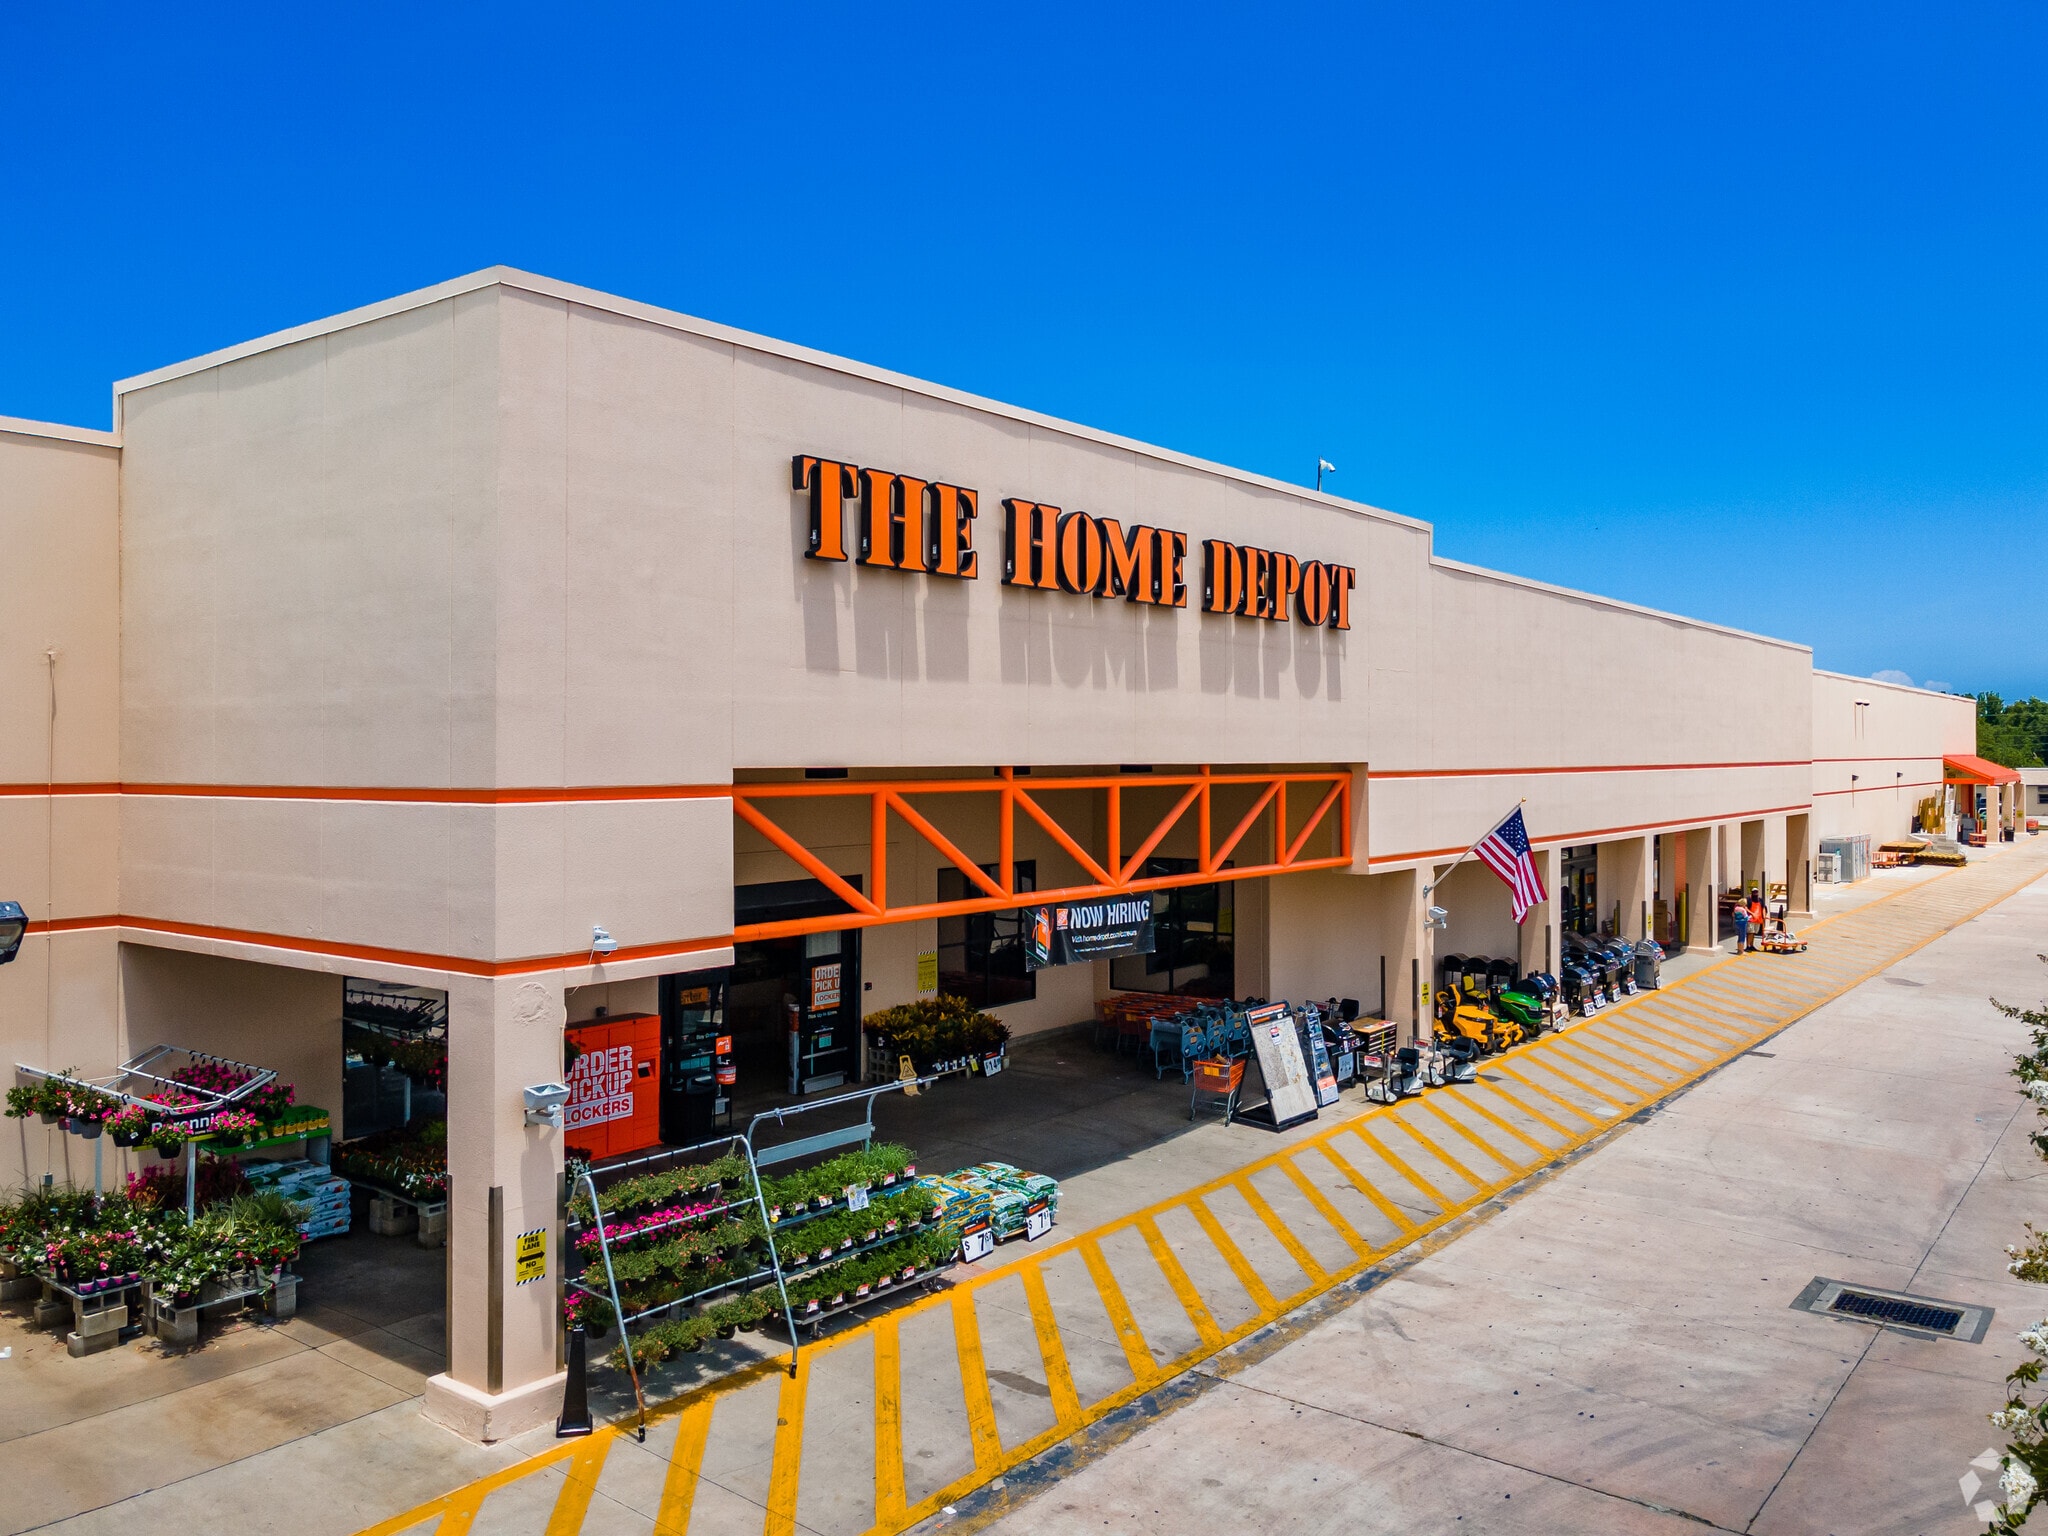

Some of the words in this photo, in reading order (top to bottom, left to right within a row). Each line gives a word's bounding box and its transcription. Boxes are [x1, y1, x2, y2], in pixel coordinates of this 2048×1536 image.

[793, 455, 979, 580] THE
[1002, 498, 1188, 608] HOME
[1202, 539, 1356, 630] DEPOT
[1070, 905, 1102, 929] NOW
[1107, 900, 1150, 926] HIRING
[814, 966, 841, 981] ORDE
[815, 980, 833, 992] PICK
[834, 978, 841, 989] U
[816, 993, 840, 1002] LOCKER
[564, 1098, 630, 1125] LOCKERS
[522, 1241, 540, 1251] LANE
[524, 1235, 539, 1244] FIRE
[525, 1261, 537, 1269] NO
